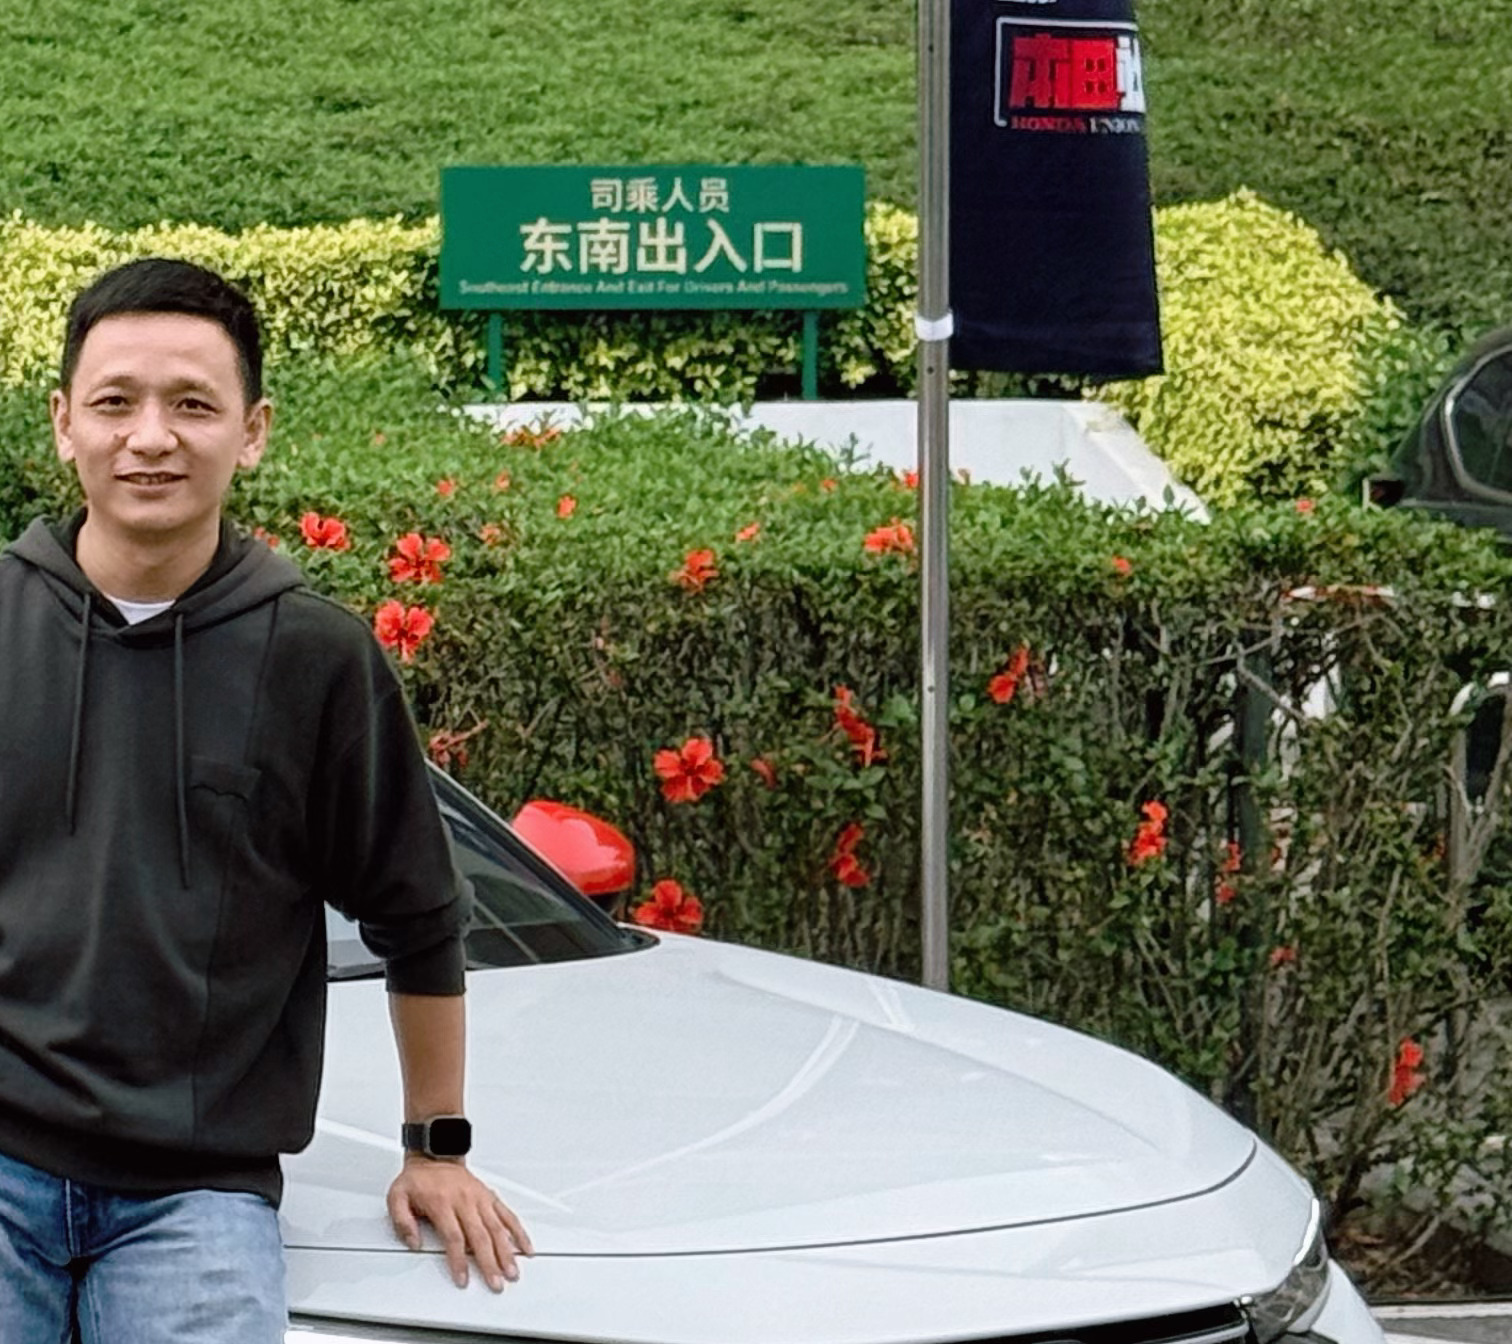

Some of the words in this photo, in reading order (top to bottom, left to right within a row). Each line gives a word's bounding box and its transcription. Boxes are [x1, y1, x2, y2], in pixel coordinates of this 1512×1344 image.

[1011, 116, 1087, 132] HONDA
[590, 178, 730, 214] 司乘人员
[519, 217, 803, 275] 东南出入口
[531, 280, 592, 294] Entrance
[596, 280, 625, 293] And
[656, 280, 680, 293] For
[737, 280, 766, 293] And
